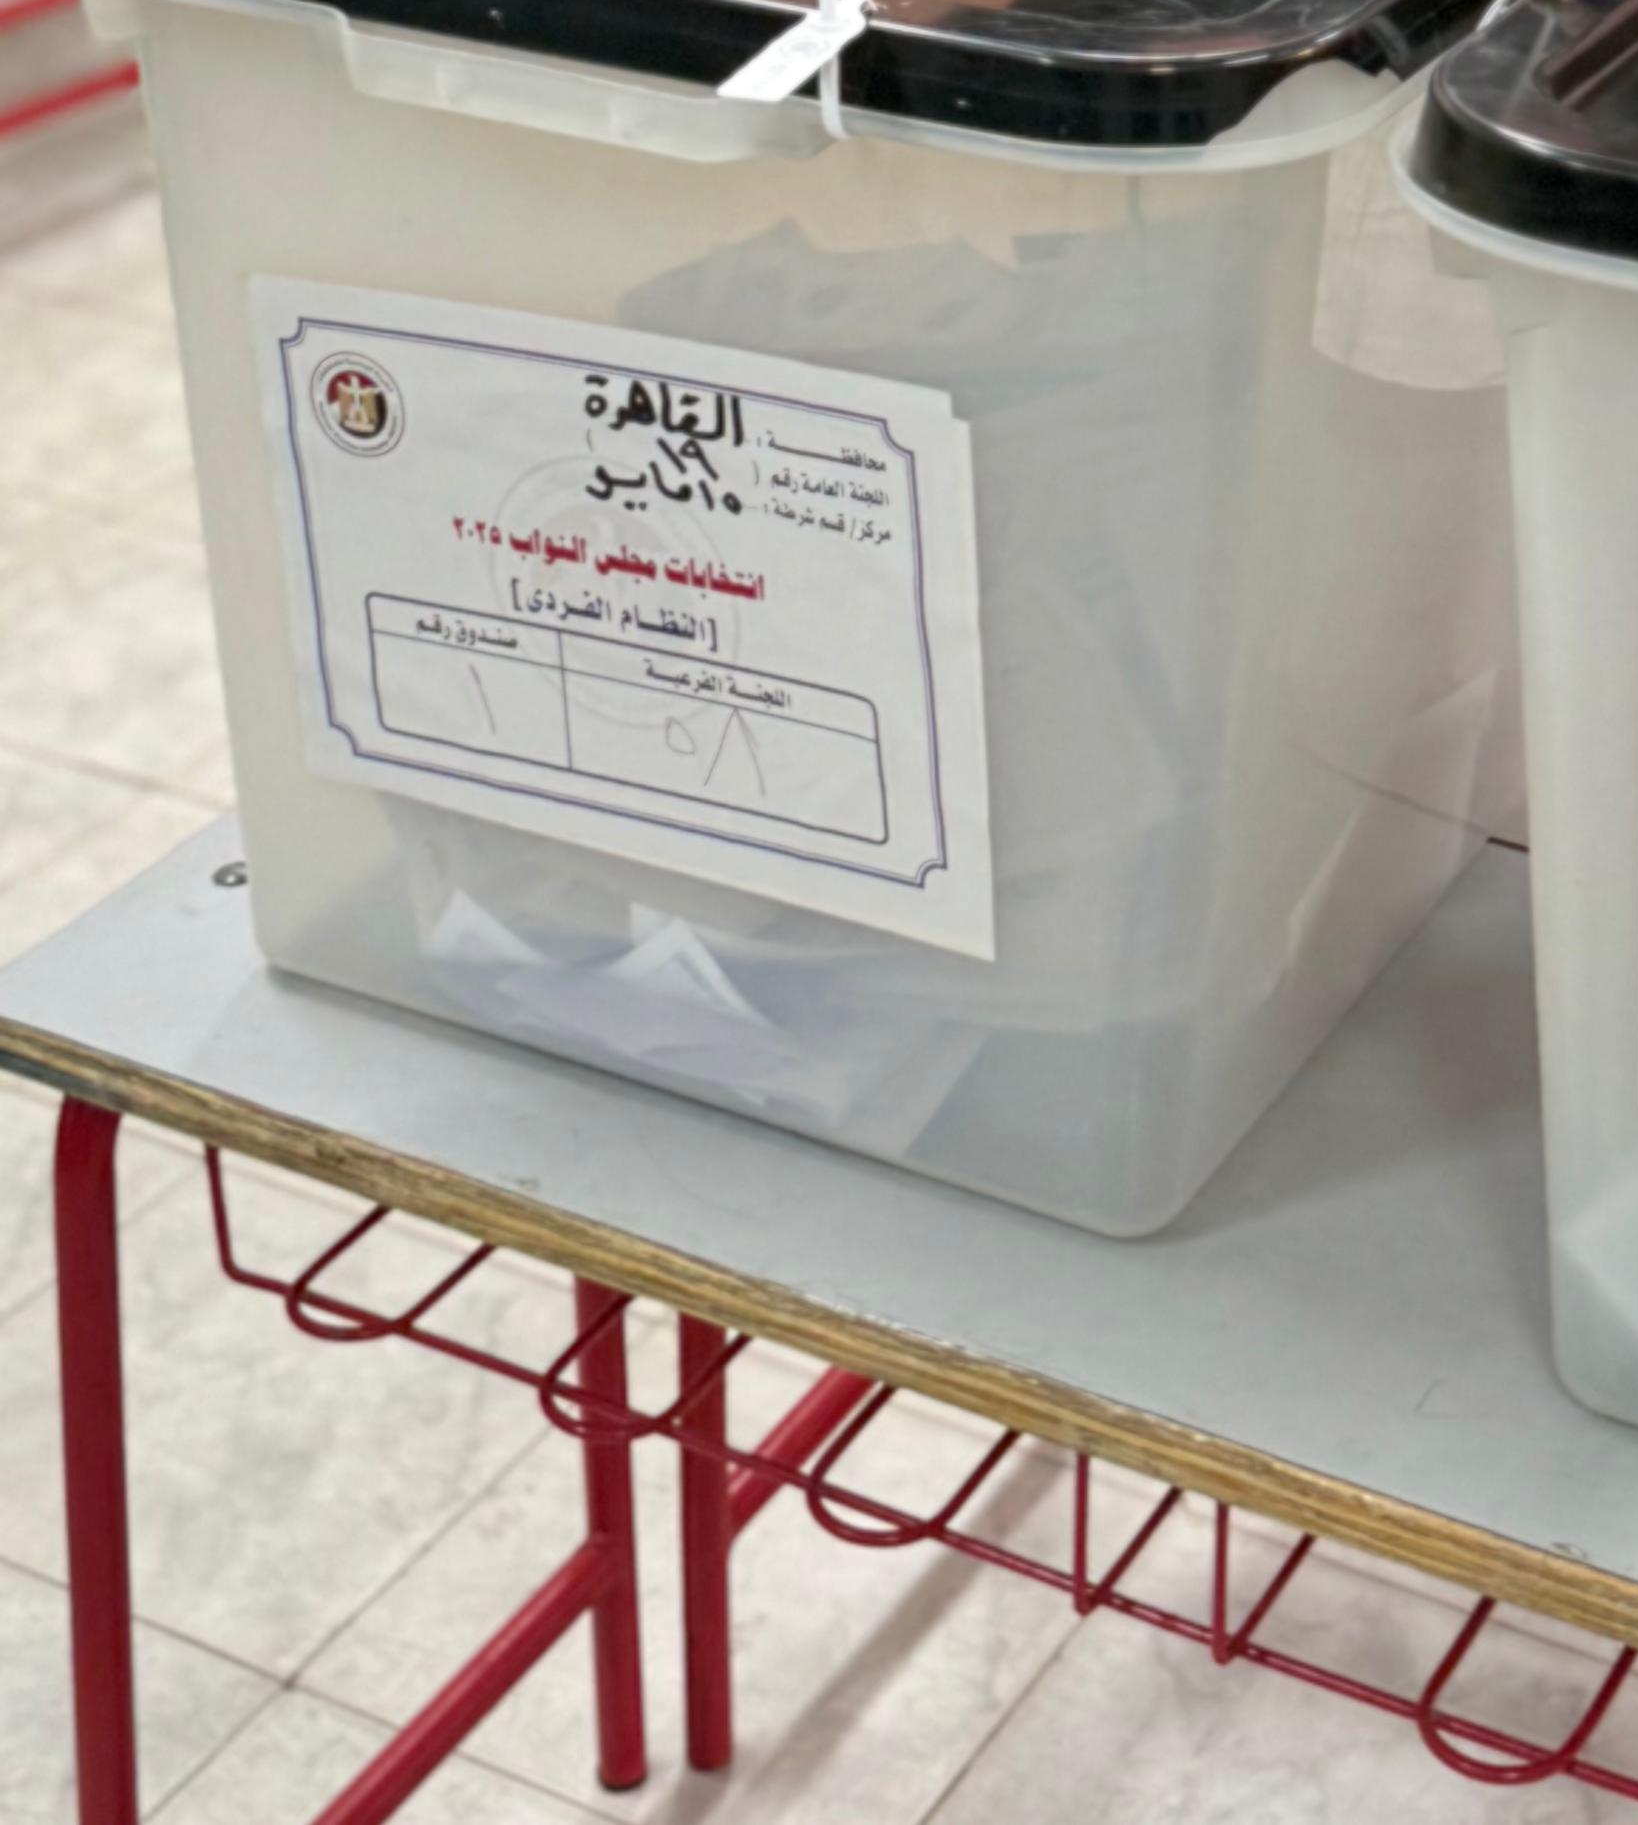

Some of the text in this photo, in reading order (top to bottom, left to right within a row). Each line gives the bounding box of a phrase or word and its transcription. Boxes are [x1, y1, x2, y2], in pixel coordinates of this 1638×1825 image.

[584, 373, 745, 449] القاهرة
[802, 470, 845, 497] العامة
[818, 513, 846, 534] قسم
[452, 517, 765, 601] انتخابات مجلس النواب ٢٠٢٥
[415, 617, 519, 650] صندوق رقم
[643, 658, 792, 709] اللجنة الفرعية
